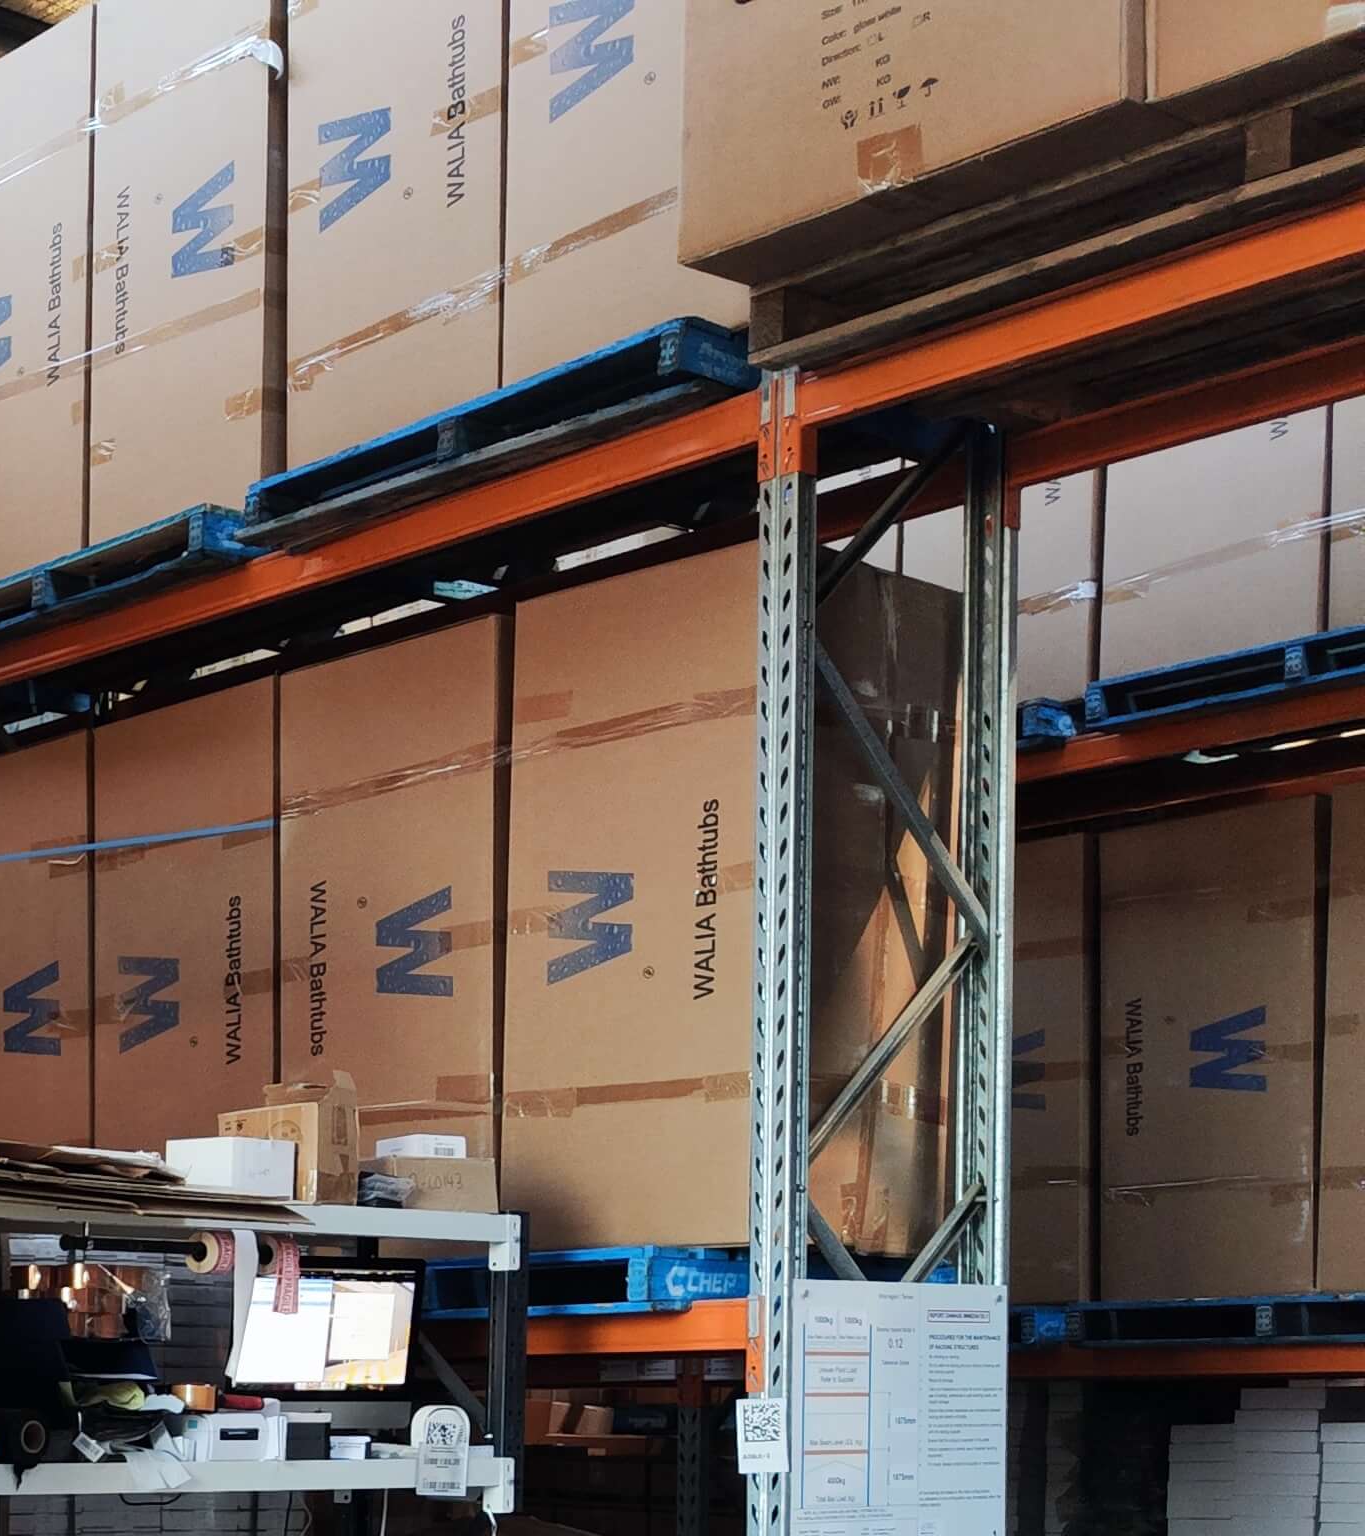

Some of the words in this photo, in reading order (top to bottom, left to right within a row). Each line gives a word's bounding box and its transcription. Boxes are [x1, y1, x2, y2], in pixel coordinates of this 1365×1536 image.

[447, 14, 466, 121] Bathtubs
[446, 121, 466, 208] WALIA
[48, 222, 63, 311] Bathtubs
[116, 185, 130, 262] WALIA
[46, 314, 61, 387] WALIA
[115, 263, 129, 355] Bathtubs
[695, 798, 720, 908] Bathtubs
[225, 895, 241, 991] Bathtubs
[310, 880, 327, 959] WALIA
[693, 911, 717, 1000] WALIA
[225, 991, 241, 1065] WALIA
[309, 960, 327, 1057] Bathtubs
[1125, 998, 1142, 1058] WALIA
[1125, 1062, 1144, 1137] Bathtubs
[687, 1270, 737, 1294] CHEP
